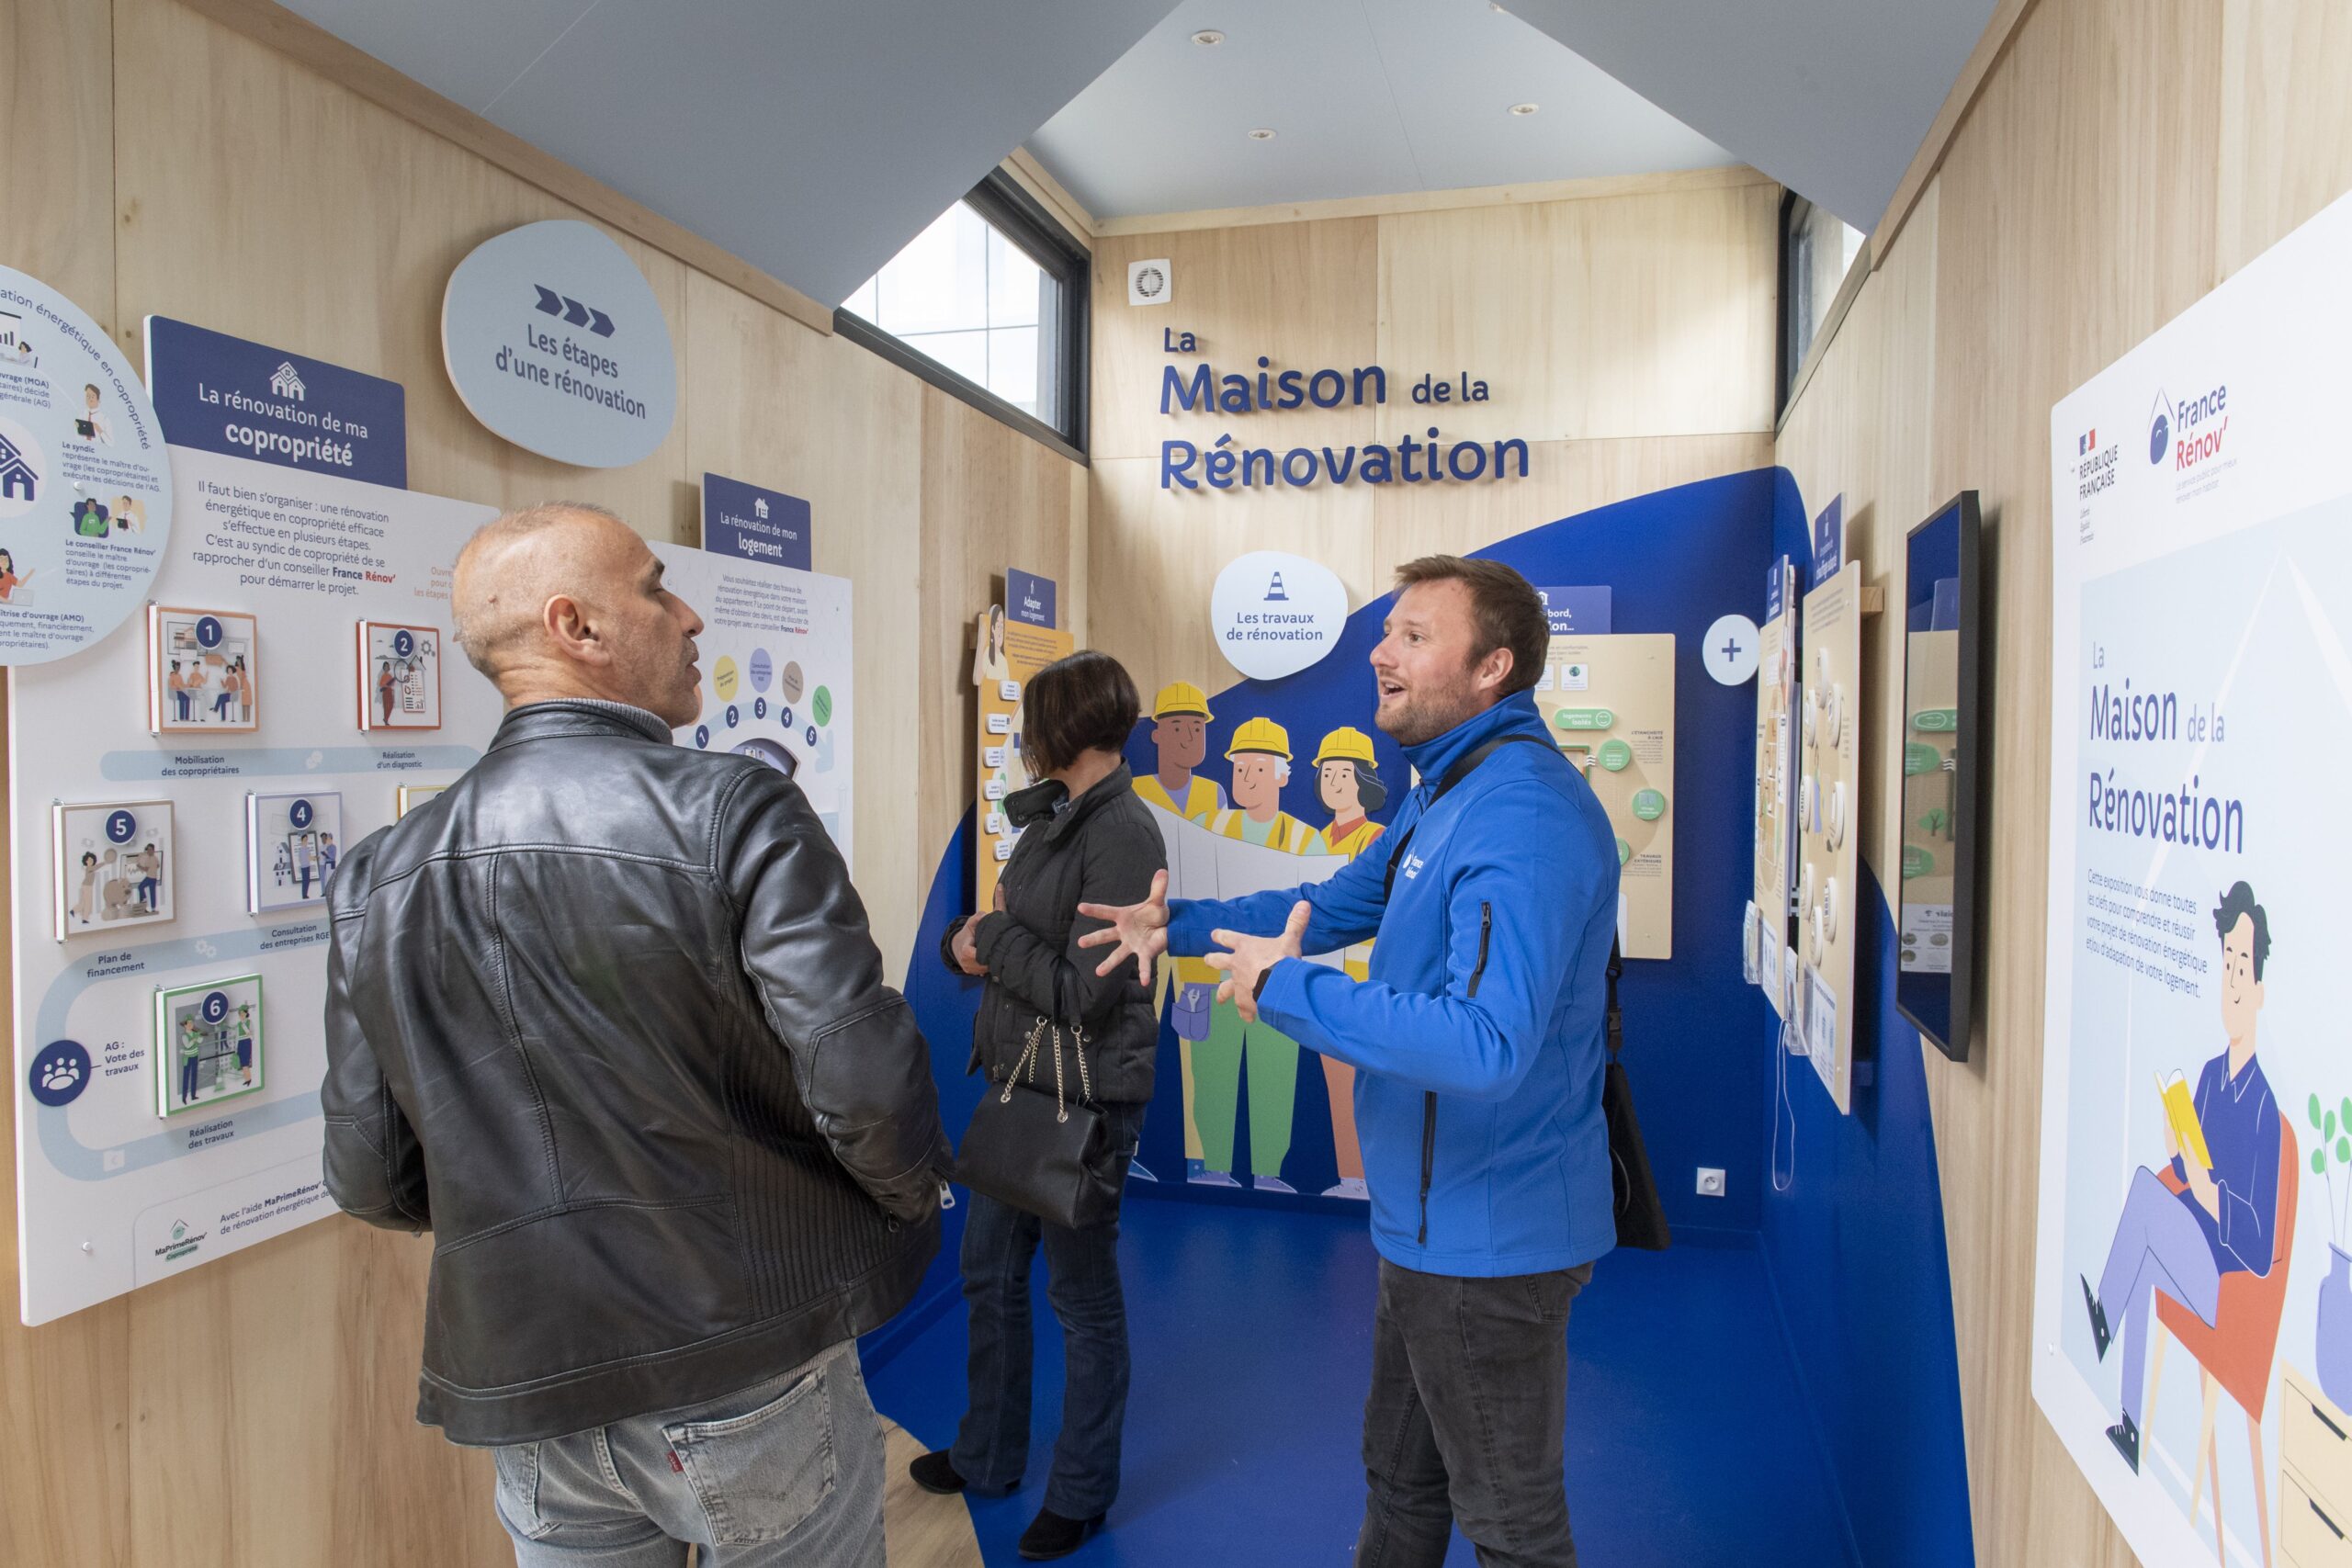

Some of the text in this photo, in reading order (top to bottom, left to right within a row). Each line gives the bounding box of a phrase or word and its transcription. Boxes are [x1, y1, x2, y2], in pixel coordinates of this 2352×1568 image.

[1164, 327, 1196, 353] La
[528, 324, 618, 378] Les étapes
[24, 375, 50, 389] (MOA)
[36, 303, 100, 360] énergétique
[100, 360, 114, 377] en
[113, 378, 151, 449] copropriété
[496, 345, 646, 419] d'une rénovation
[1159, 356, 1489, 414] Maison de la
[25, 387, 50, 398] décide
[33, 398, 51, 409] (AG)
[199, 382, 368, 438] La rénovation de ma
[2178, 385, 2226, 432] France
[73, 443, 95, 453] syndic
[225, 423, 353, 467] copropriété
[2177, 416, 2228, 471] Rénov'
[1161, 427, 1529, 489] Rénovation
[2080, 445, 2118, 479] RÉPUBLIQUE
[2080, 468, 2114, 501] FRANÇAISE
[198, 480, 205, 492] Il
[208, 481, 230, 497] faut
[233, 487, 256, 502] bien
[260, 492, 312, 510] s'organiser
[321, 503, 338, 514] une
[341, 506, 390, 523] rénovation
[205, 499, 384, 537] énergétique en copropriété efficace
[720, 512, 797, 540] La rénovation de mon
[222, 519, 371, 551] s'effectue en plusieurs étapes.
[75, 540, 108, 550] conseiller
[110, 544, 131, 553] France
[206, 534, 385, 568] C'est au syndic de copropriété de se
[739, 533, 782, 557] logement
[193, 551, 396, 583] rapprocher d'un conseiller France Rénov'
[240, 574, 358, 597] pour démarrer le projet.
[1024, 597, 1041, 610] Adapter
[22, 611, 59, 621] d'ouvrage
[61, 614, 84, 623] (AMO)
[1030, 610, 1045, 622] logement
[1238, 612, 1314, 624] Les travaux
[205, 625, 213, 640] 1
[1227, 627, 1322, 640] de rénovation
[401, 637, 408, 651] 2
[2093, 642, 2104, 669] La
[729, 711, 736, 723] 2
[758, 703, 763, 714] 3
[785, 713, 789, 723] 4
[2091, 677, 2224, 742] Maison de la
[808, 730, 813, 741] 5
[175, 755, 225, 764] Mobilisation
[382, 750, 415, 760] Réalisation
[162, 765, 239, 778] des copropriétaires
[377, 760, 423, 770] d'un diagnostic
[296, 807, 307, 822] 4
[2089, 766, 2243, 854] Rénovation
[116, 818, 126, 836] 5
[2087, 869, 2197, 915] Cette exposition vous donne toutes
[2086, 892, 2095, 905] les
[2109, 901, 2121, 915] pour
[2123, 906, 2161, 930] comprendre
[2163, 918, 2170, 931] et
[2172, 919, 2195, 941] réussir
[271, 923, 317, 938] Consultation
[260, 931, 330, 951] des entreprises RGE
[2086, 916, 2207, 974] votre projet de rénovation énergétique
[98, 952, 131, 964] Plan de
[86, 962, 145, 978] financement
[2135, 957, 2143, 973] de
[2145, 964, 2163, 982] votre
[2164, 966, 2200, 998] logement.
[209, 999, 220, 1016] 6
[105, 1042, 119, 1052] AG
[105, 1049, 144, 1065] Vote des
[105, 1063, 139, 1077] travaux
[189, 1120, 233, 1138] Réalisation
[188, 1131, 234, 1150] des travaux
[220, 1213, 240, 1224] Avec
[243, 1202, 263, 1216] l'aide
[265, 1180, 322, 1208] MaPrimeRénov'
[220, 1225, 231, 1235] de
[233, 1212, 275, 1230] rénovation
[276, 1193, 320, 1216] énergétique
[155, 1232, 208, 1257] MaPrimeRénov'
